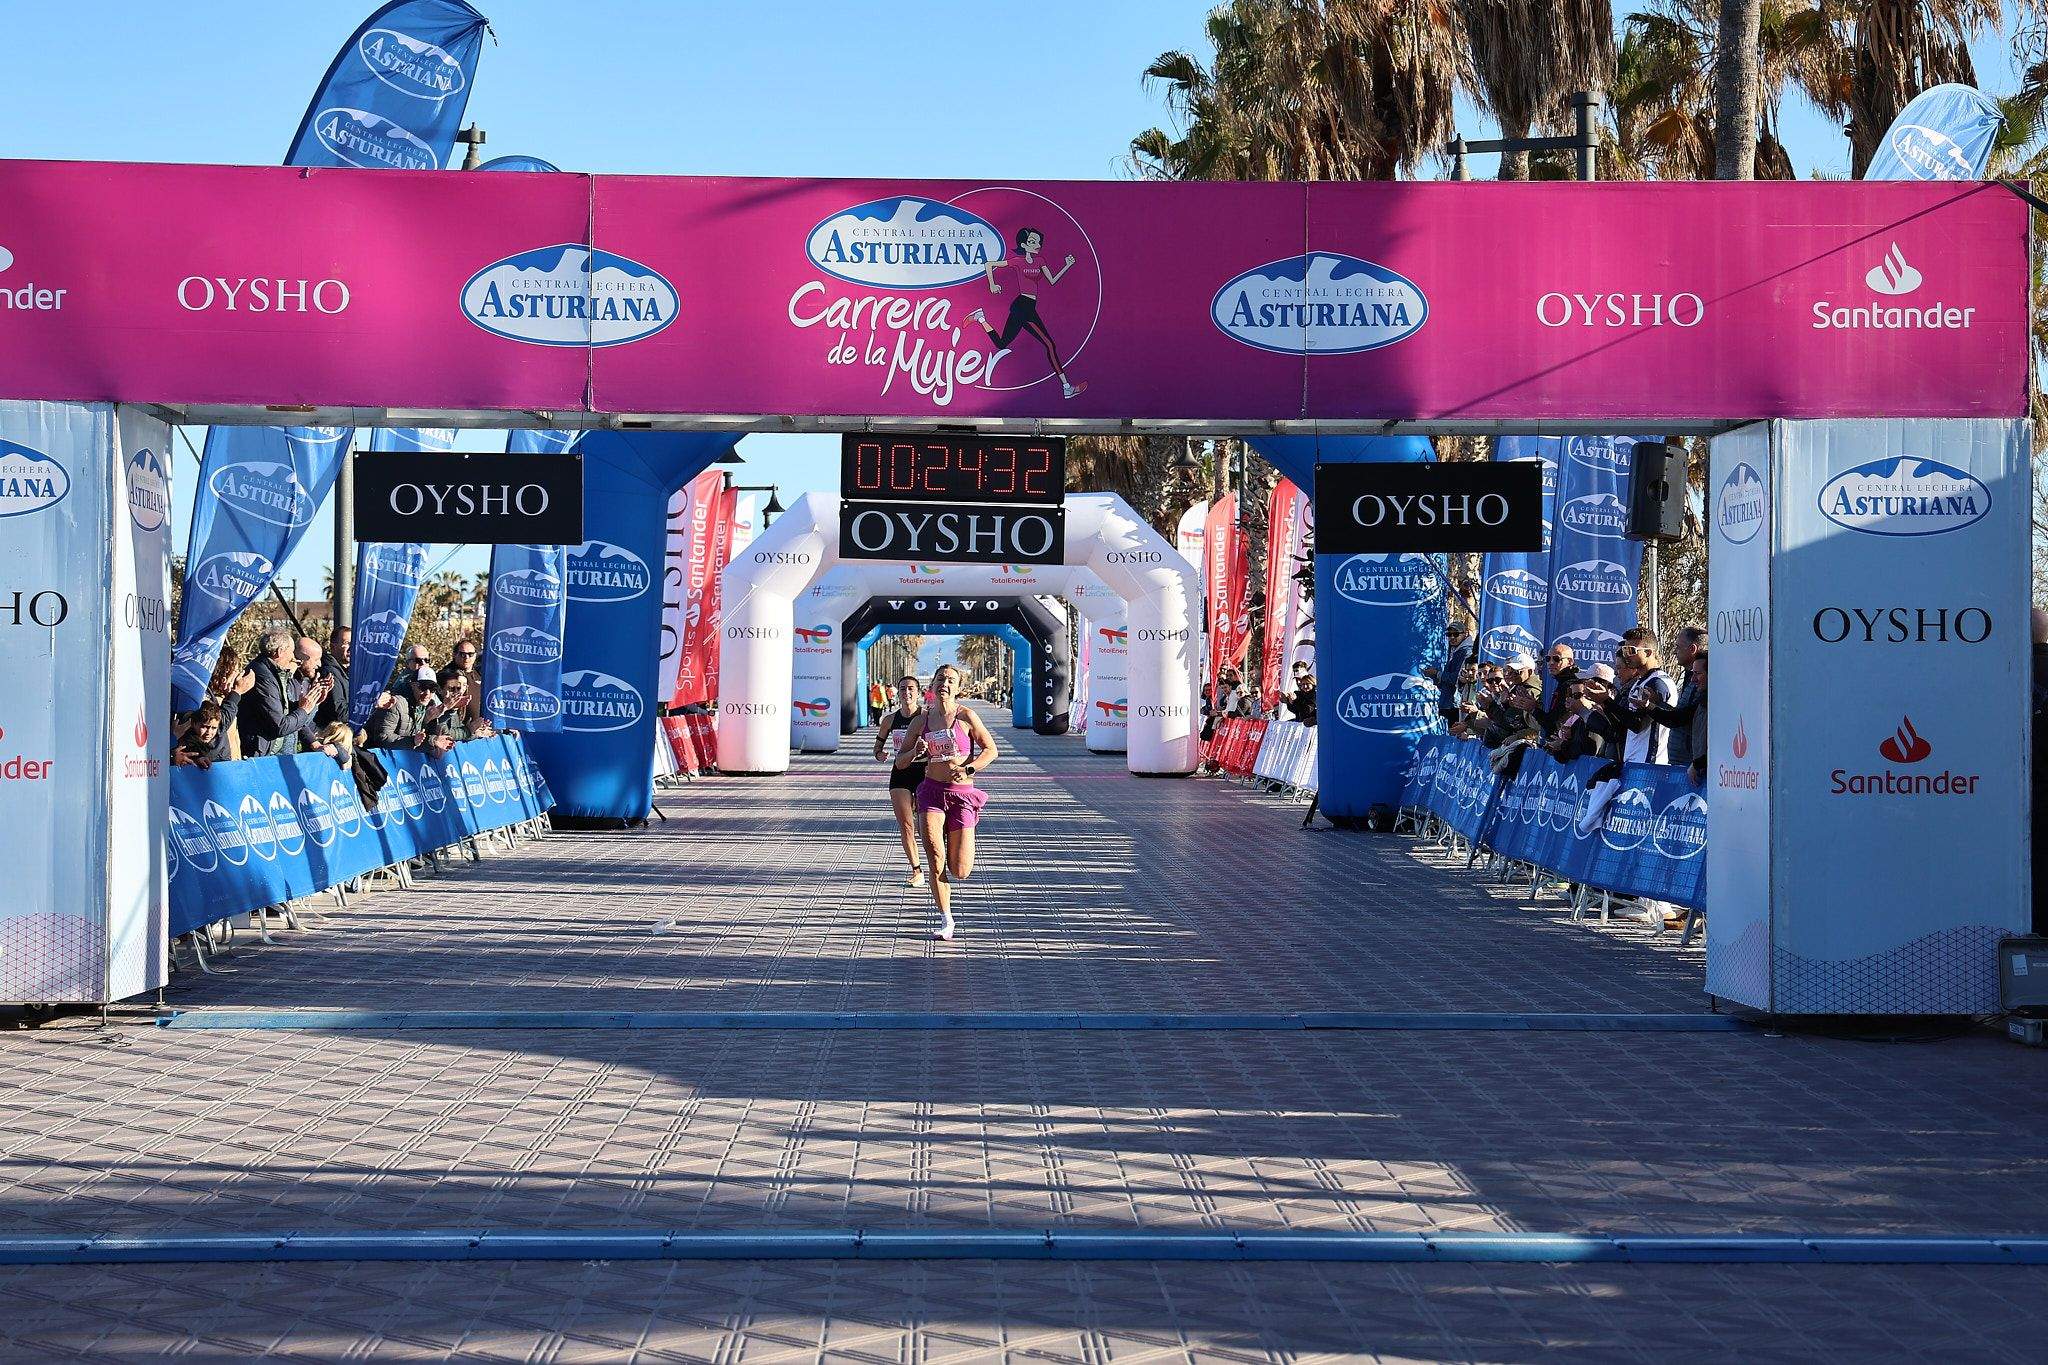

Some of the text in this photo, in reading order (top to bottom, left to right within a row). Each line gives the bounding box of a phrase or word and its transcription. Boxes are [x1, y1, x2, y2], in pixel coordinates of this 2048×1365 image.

[852, 228, 984, 238] CENTRAL LECHERA
[821, 229, 988, 265] ASTURIANA
[177, 276, 351, 315] OYSHO
[512, 279, 656, 291] CENTRAL LECHERA
[1262, 288, 1404, 298] CENTRAL LECHERA
[477, 280, 663, 321] ASTURIANA
[788, 280, 952, 331] Carrera
[1228, 290, 1412, 328] ASTURIANA
[1536, 292, 1704, 328] OYSHO
[1812, 301, 1975, 329] Santander
[827, 327, 1013, 406] de la Mujer
[857, 443, 1049, 494] 00:24:32
[129, 474, 165, 514] ASTURIANA
[389, 483, 550, 516] OYSHO
[1831, 485, 1979, 517] ASTURIANA
[1857, 484, 1973, 493] CENTRAL LECHERA
[1352, 493, 1509, 527] OYSHO
[1720, 497, 1763, 527] ASTURIANA
[851, 510, 1054, 556] OYSHO
[754, 552, 811, 565] OYSHO
[1106, 551, 1162, 564] OYSHO
[1276, 497, 1295, 598] Santander
[602, 561, 642, 571] LECHERA
[710, 519, 727, 608] Santander
[1215, 524, 1228, 610] Santander
[676, 498, 708, 690] Sports Santander
[899, 577, 944, 585] TotalEnergies
[991, 577, 1036, 585] TotalEnergies
[125, 592, 166, 634] OYSHO
[888, 600, 999, 611] VOLVO
[727, 626, 779, 639] OYSHO
[1138, 629, 1190, 641] OYSHO
[1716, 605, 1764, 645] OYSHO
[1812, 606, 1992, 644] OYSHO
[494, 636, 559, 657] ASTURIANA
[794, 647, 832, 655] TotalEnergies
[1098, 647, 1127, 656] TotalEnerg
[596, 691, 634, 700] LECHERA
[1044, 644, 1053, 723] VOLVO
[489, 693, 556, 714] ASTURIANA
[725, 702, 777, 715] OYSHO
[1138, 705, 1190, 718] OYSHO
[792, 720, 831, 728] TotalEnergies
[124, 754, 161, 780] Santander
[1719, 764, 1760, 791] Santander
[1831, 768, 1979, 795] Santander
